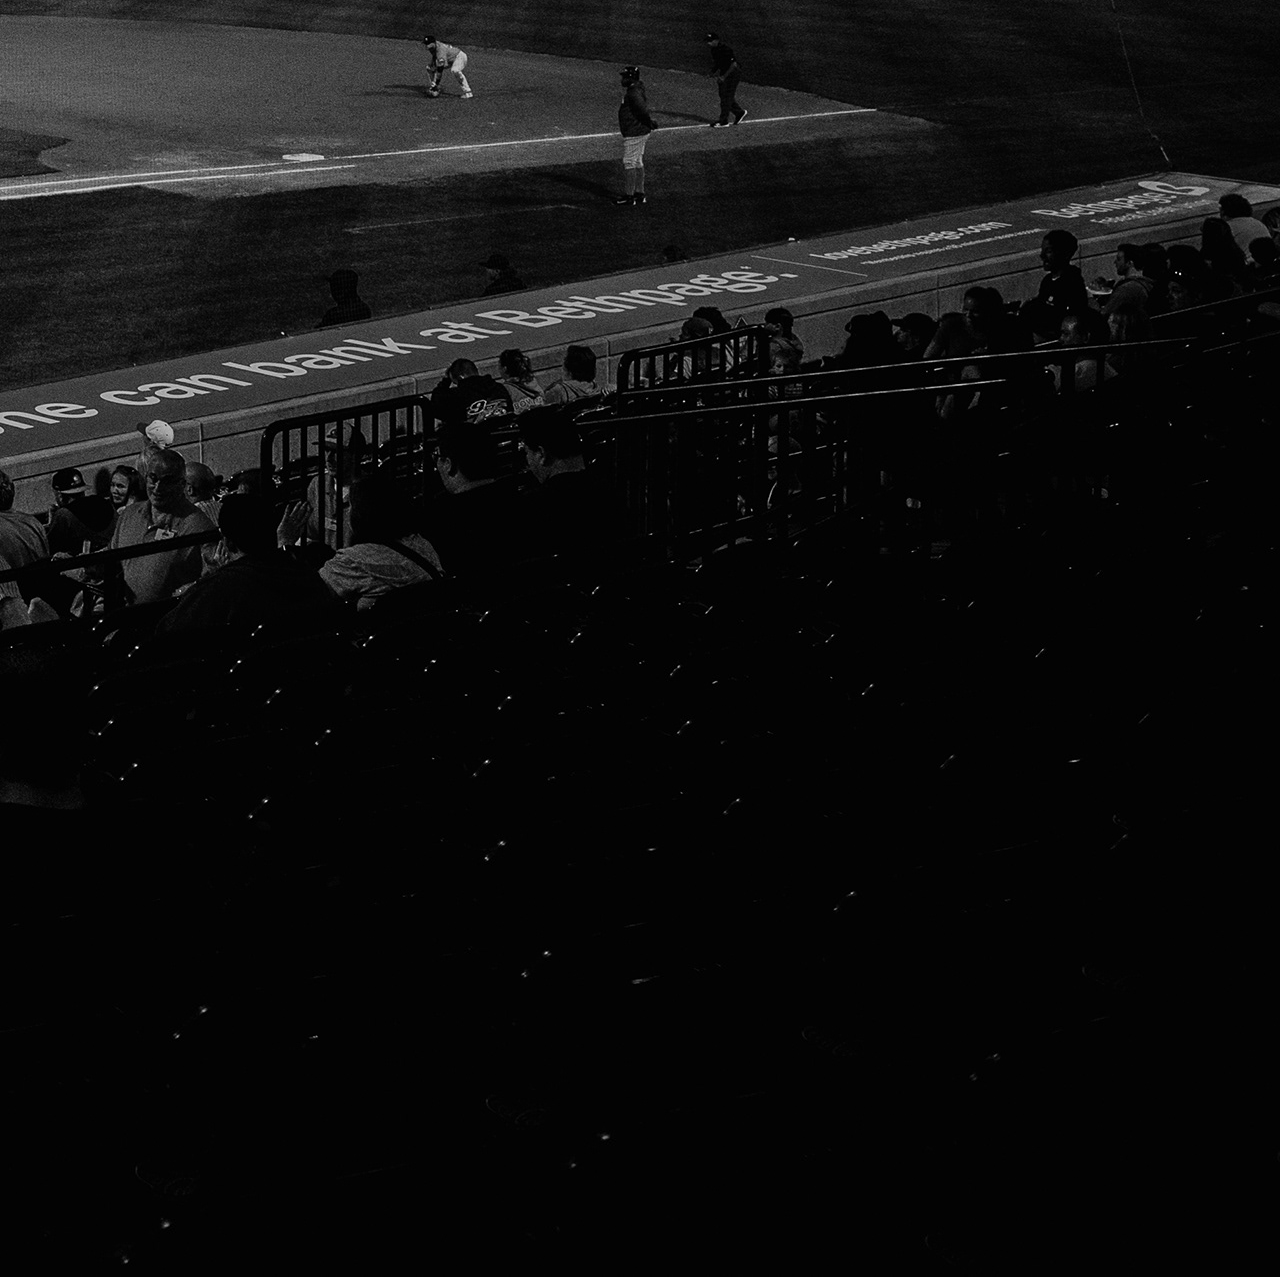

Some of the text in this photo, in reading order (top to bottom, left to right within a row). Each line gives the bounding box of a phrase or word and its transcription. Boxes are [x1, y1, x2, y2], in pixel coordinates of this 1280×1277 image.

[99, 373, 253, 407] can
[222, 337, 438, 379] bank
[419, 320, 513, 344] at
[474, 270, 799, 329] Bethpage.
